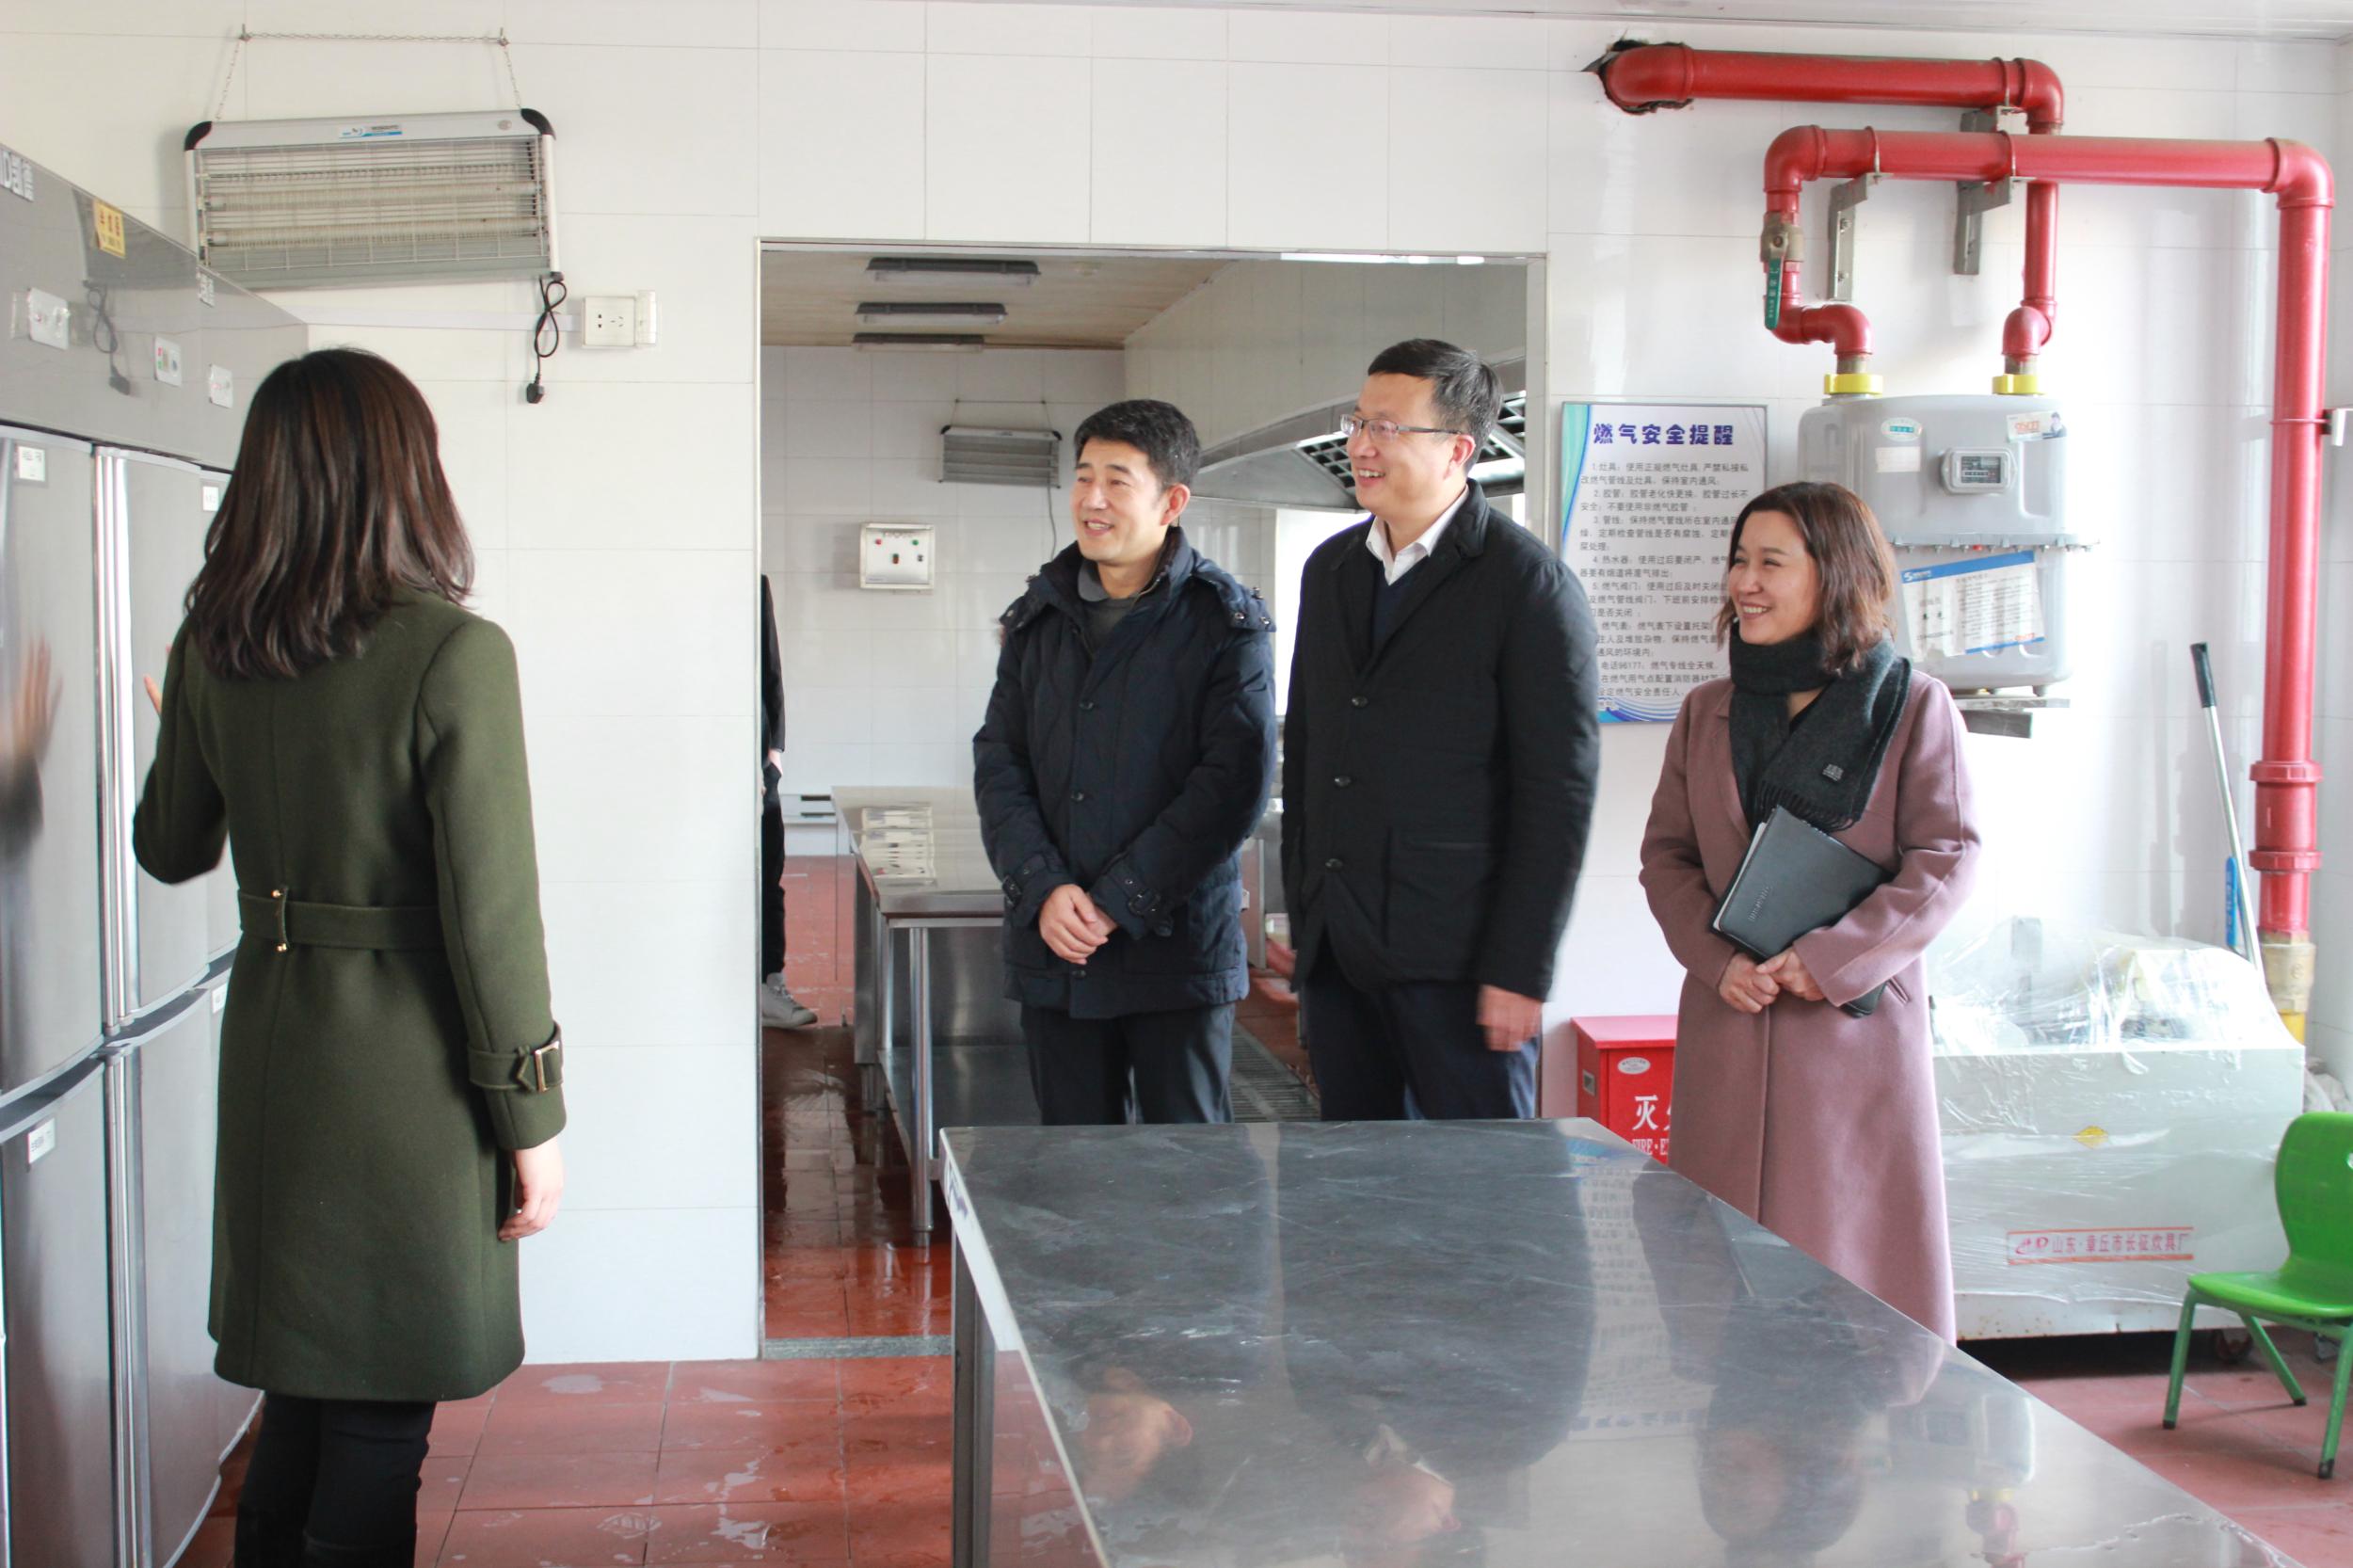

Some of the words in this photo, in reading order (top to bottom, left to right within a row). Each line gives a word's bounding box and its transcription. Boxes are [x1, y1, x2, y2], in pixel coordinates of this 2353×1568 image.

[1593, 424, 1734, 445] 燃气安全提醒
[1632, 1095, 1672, 1131] 灭
